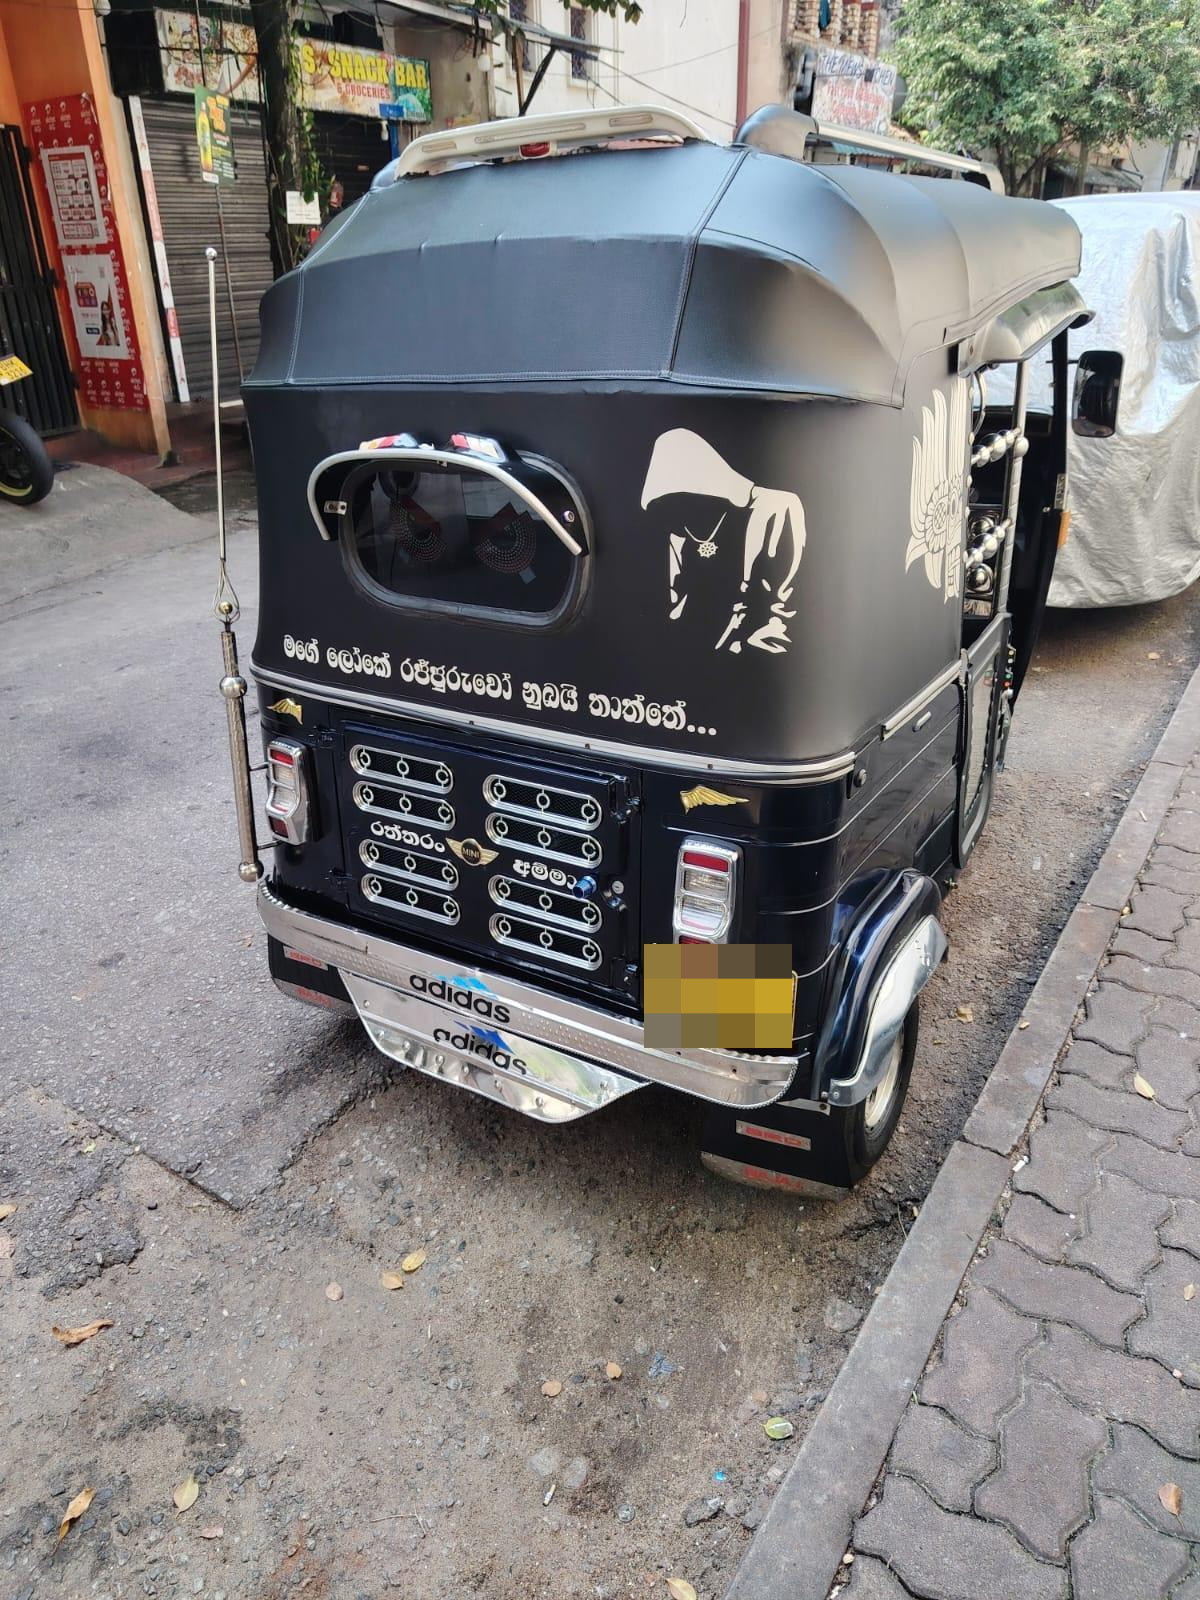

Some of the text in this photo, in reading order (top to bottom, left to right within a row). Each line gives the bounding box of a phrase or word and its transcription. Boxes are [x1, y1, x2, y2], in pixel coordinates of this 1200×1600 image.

[328, 50, 389, 84] SNACK
[394, 60, 427, 89] BAR
[345, 83, 391, 100] GROCERIES
[283, 634, 320, 664] මගේ
[326, 646, 392, 678] ලෝකේ
[370, 820, 446, 853] රත්තරං
[461, 847, 481, 859] MINI
[512, 858, 577, 890] අම්මා
[409, 974, 511, 1024] adidas
[432, 1027, 528, 1076] adidas
